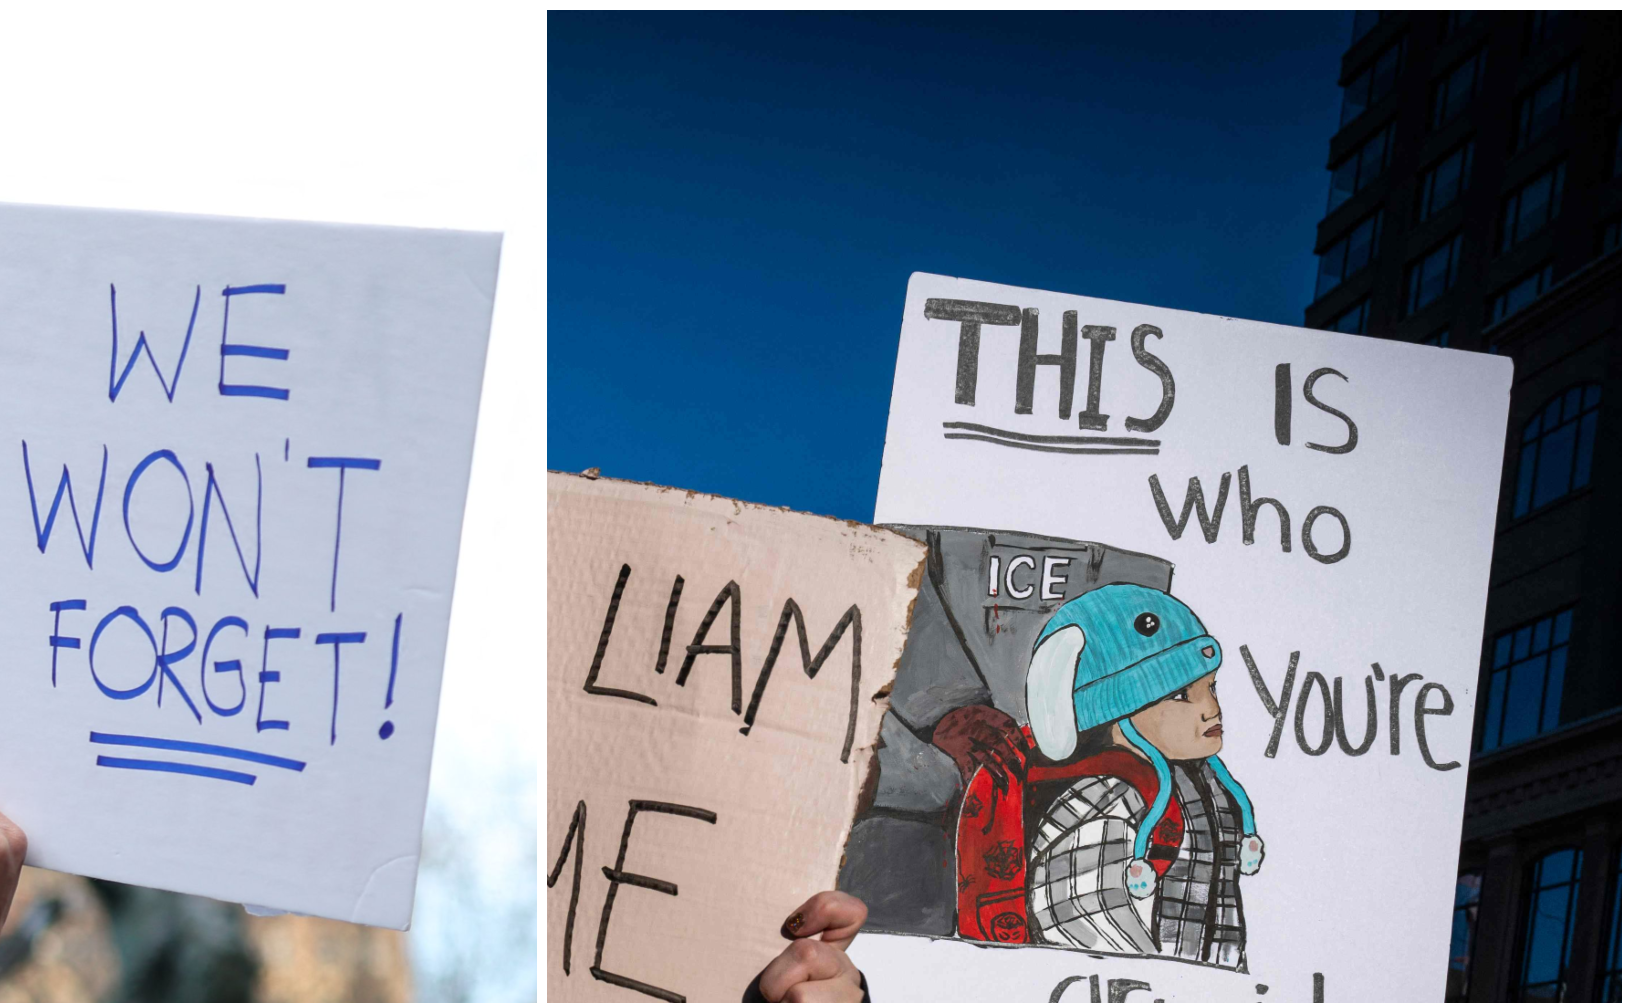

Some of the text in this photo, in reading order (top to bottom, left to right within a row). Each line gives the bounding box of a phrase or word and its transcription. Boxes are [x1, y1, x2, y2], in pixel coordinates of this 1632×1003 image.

[108, 282, 291, 402] WE
[923, 296, 1359, 455] THIS IS
[21, 438, 382, 612] WON'T
[988, 554, 1077, 600] ICE
[48, 598, 403, 745] FORGET!
[582, 562, 863, 765] LIAM
